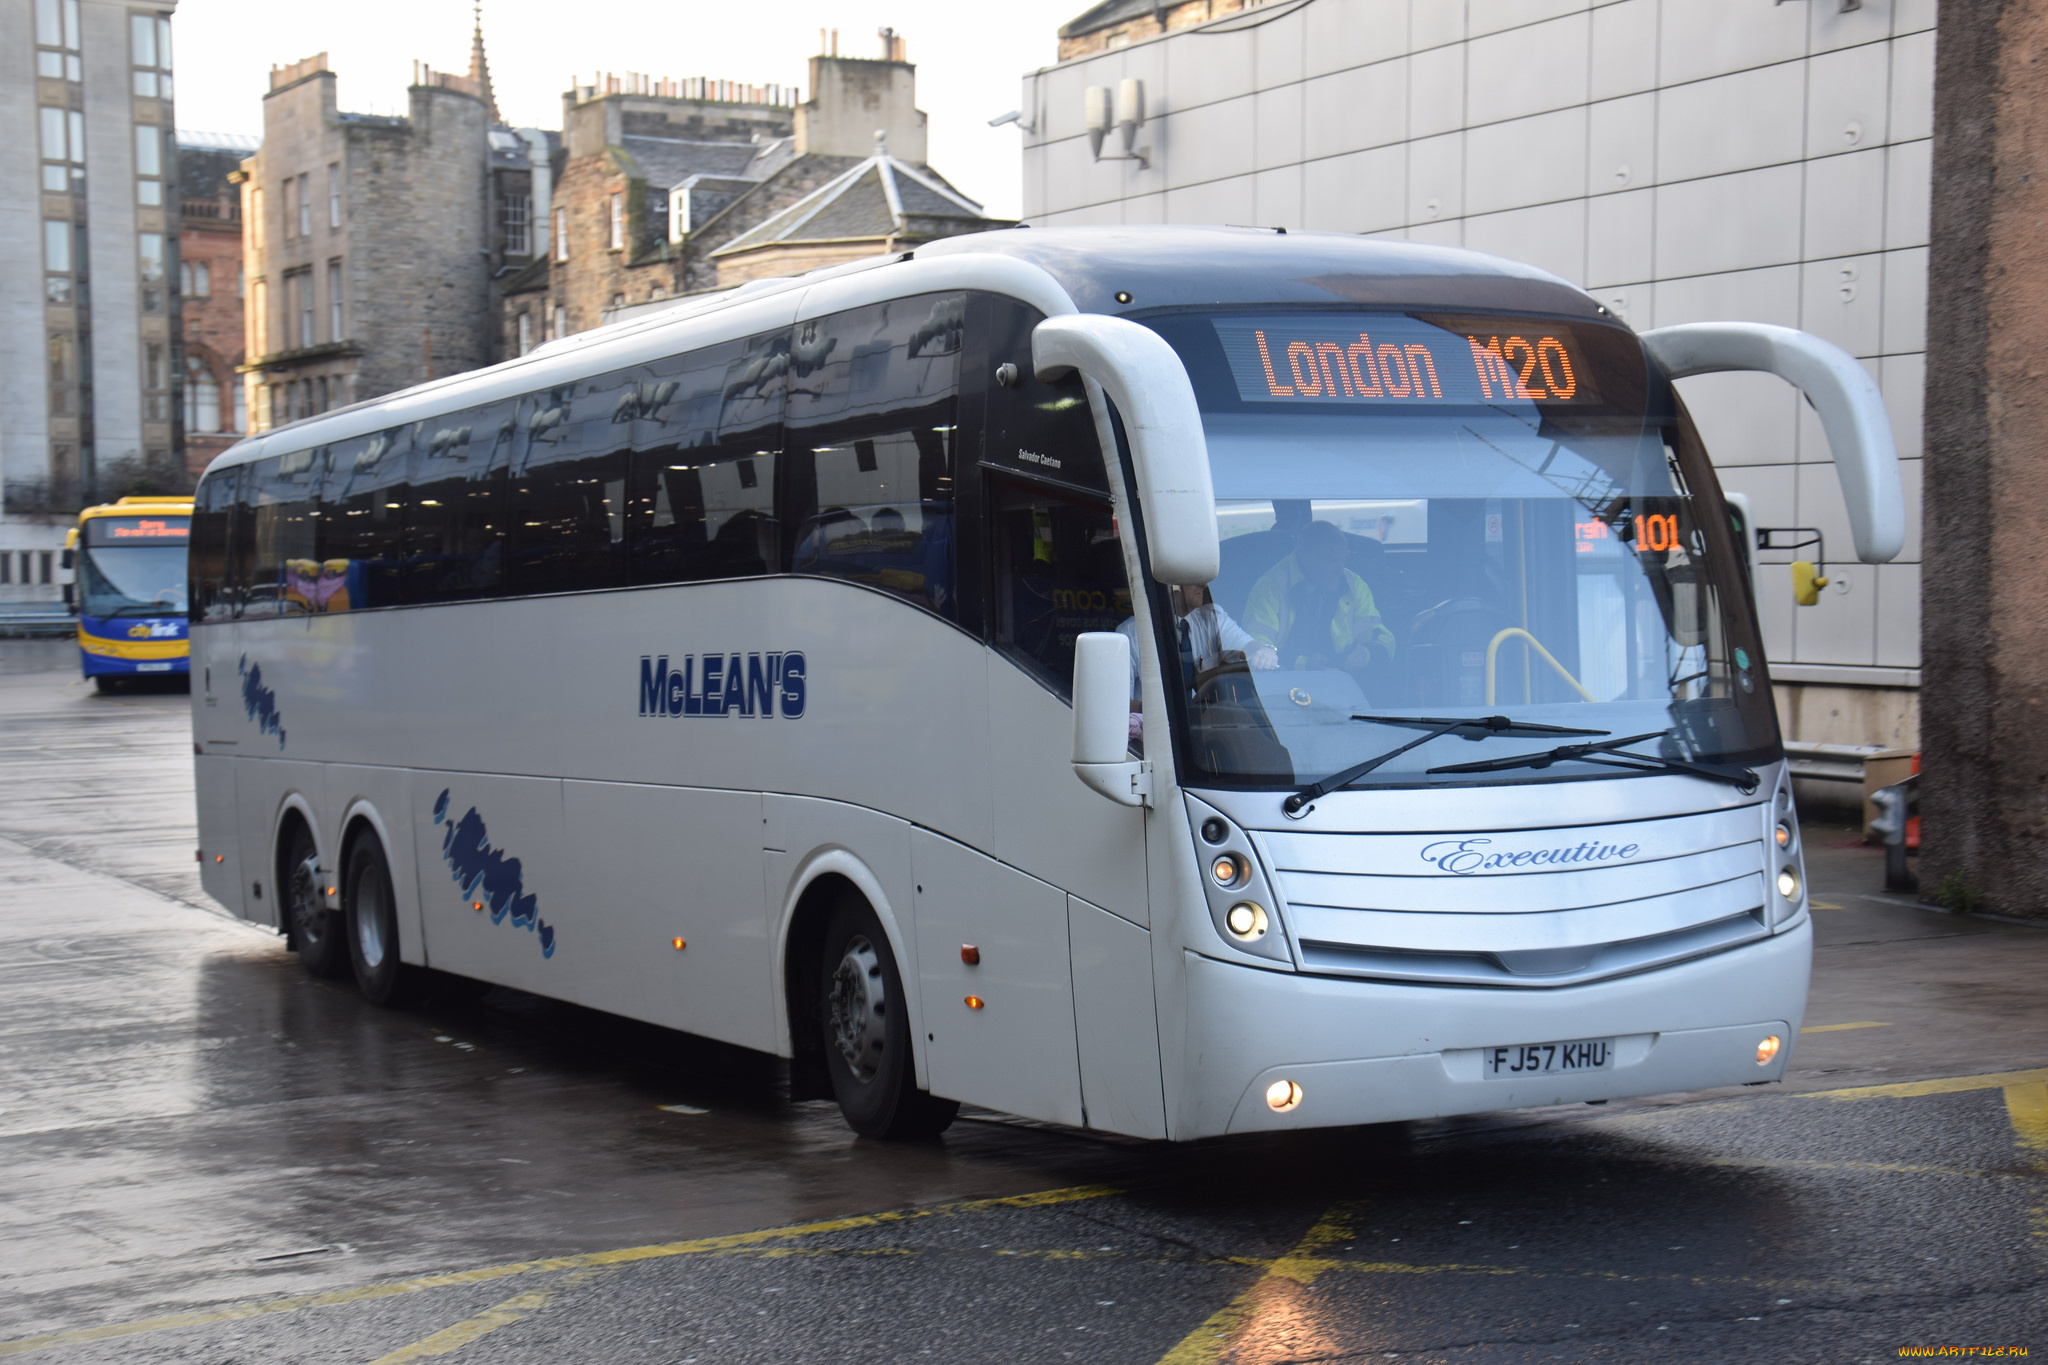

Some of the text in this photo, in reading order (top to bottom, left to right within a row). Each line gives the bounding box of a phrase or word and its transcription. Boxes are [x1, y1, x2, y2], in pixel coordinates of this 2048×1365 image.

[1255, 330, 1576, 399] London M20
[1018, 448, 1061, 469] Salvador Caetano
[1635, 514, 1681, 551] 101
[639, 651, 806, 719] McLEAN'S
[1421, 838, 1640, 875] Executive
[1494, 1042, 1606, 1073] FJ57 KHU
